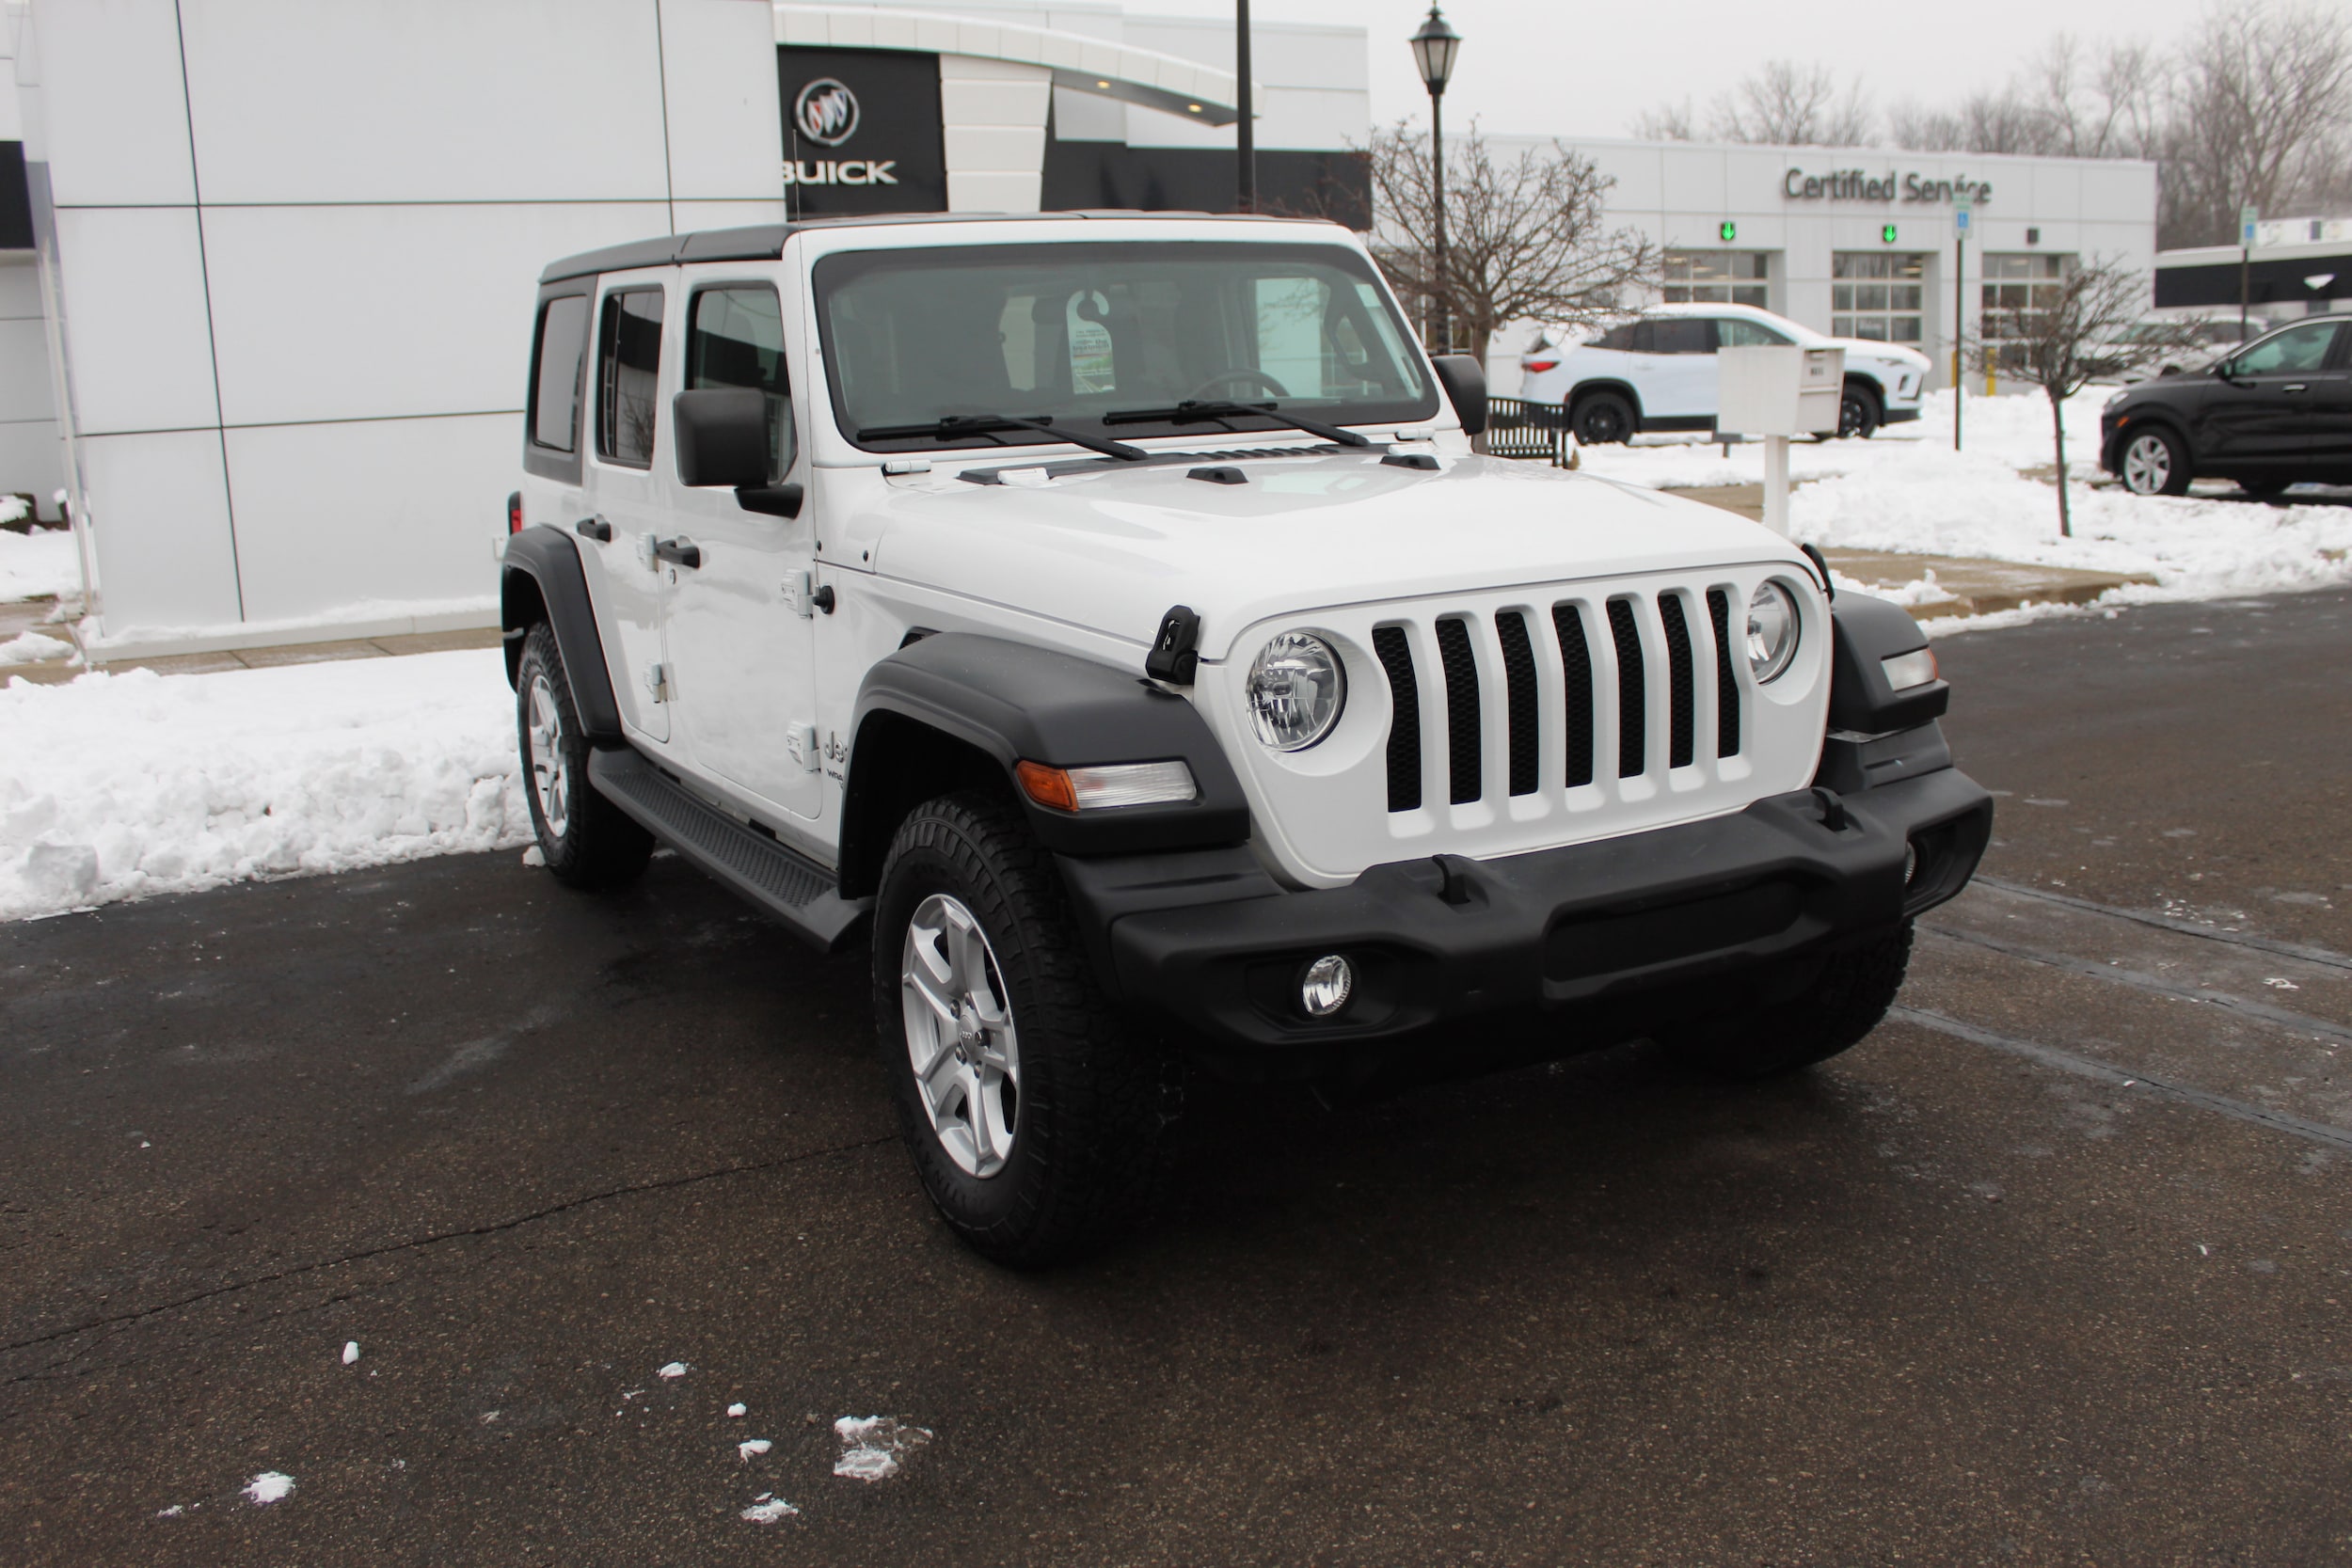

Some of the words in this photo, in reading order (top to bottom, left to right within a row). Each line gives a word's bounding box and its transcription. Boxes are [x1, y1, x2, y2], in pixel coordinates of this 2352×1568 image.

[783, 160, 898, 185] BUICK
[1786, 167, 1897, 201] Certified
[822, 730, 848, 763] Je
[826, 768, 844, 782] WRA
